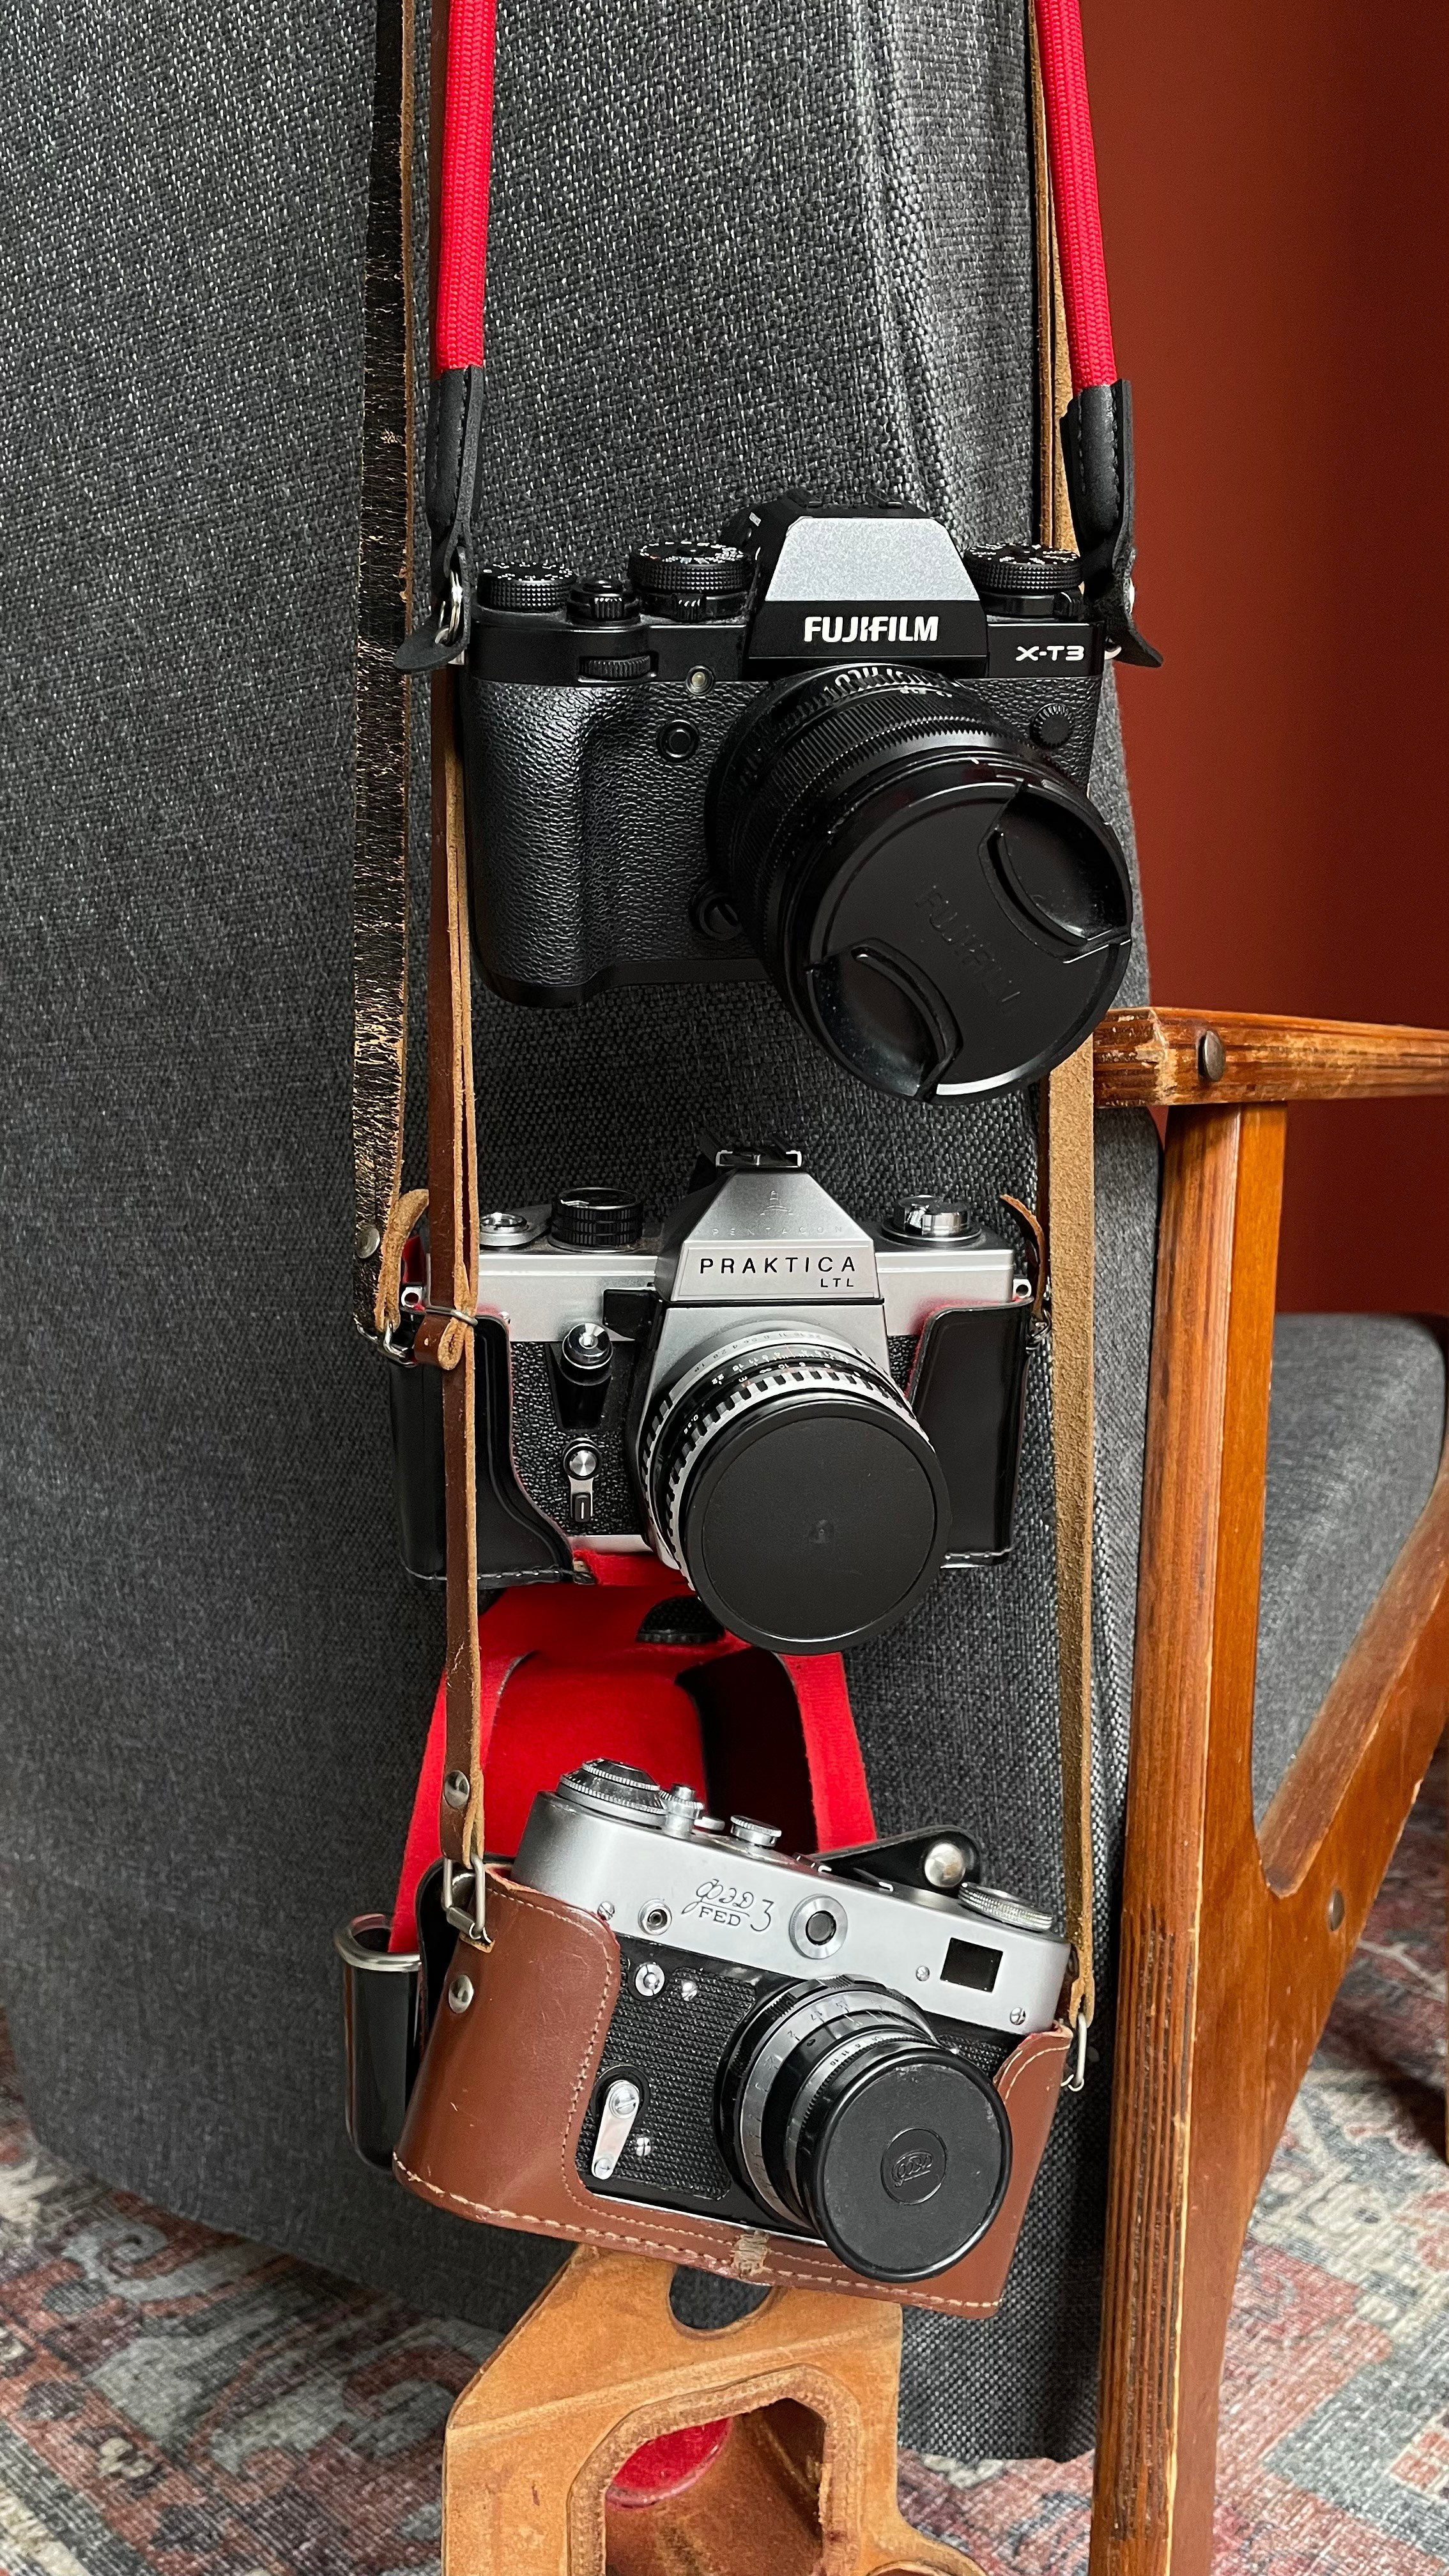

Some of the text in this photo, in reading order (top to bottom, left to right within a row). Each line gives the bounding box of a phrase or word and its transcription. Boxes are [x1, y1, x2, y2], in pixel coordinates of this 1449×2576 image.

[804, 616, 939, 643] FUJIFILM
[1015, 645, 1085, 661] X-T3
[700, 1256, 855, 1274] PRAKTICA
[820, 1278, 854, 1288] LTL
[698, 1906, 741, 1927] FED
[750, 1899, 774, 1932] 3
